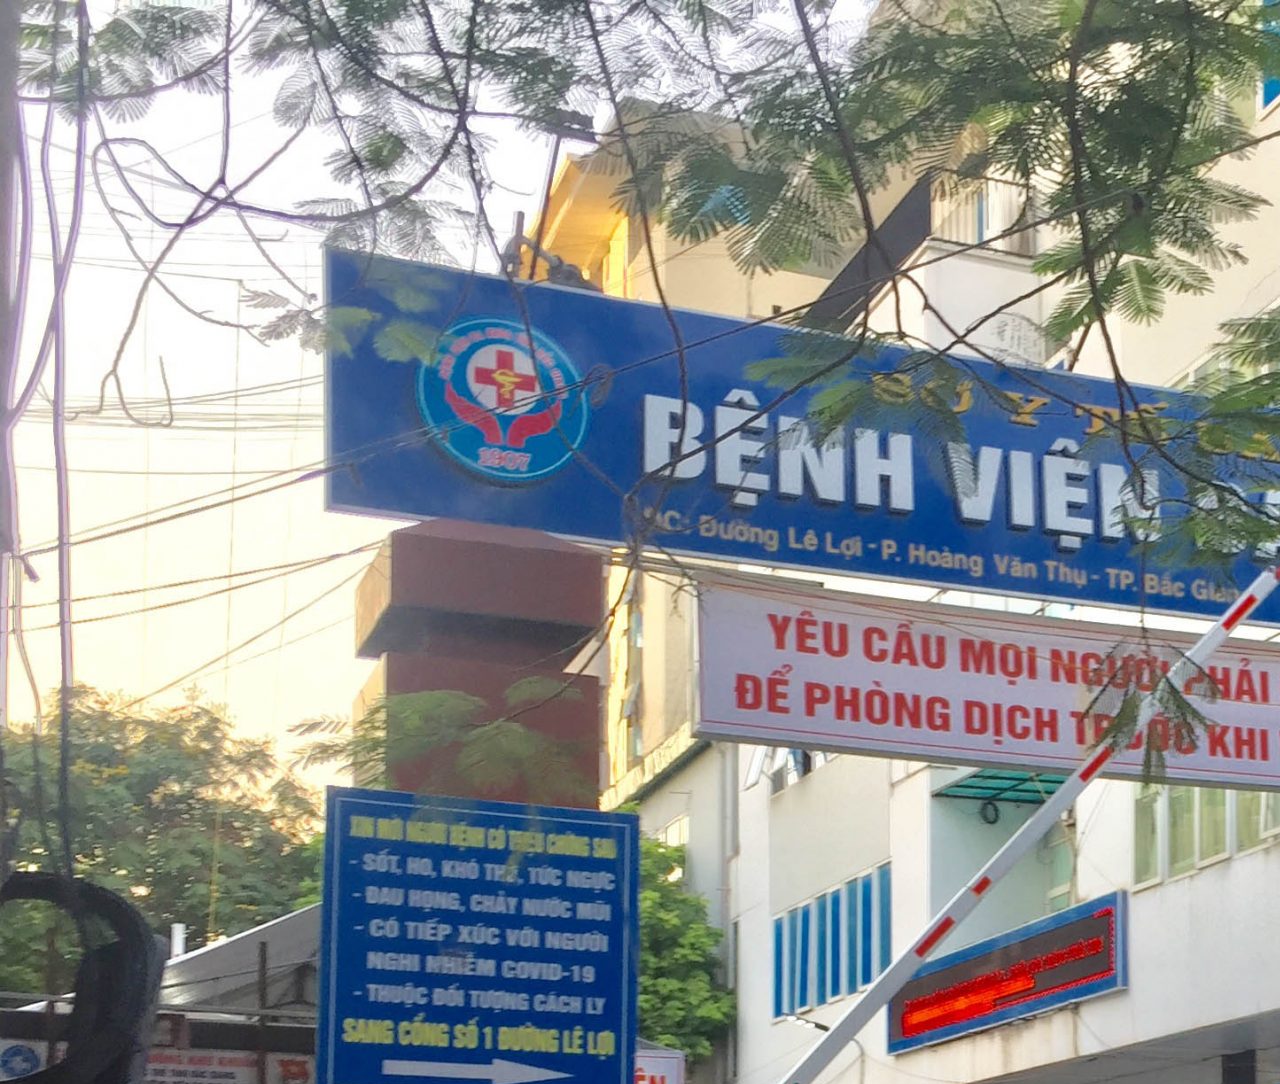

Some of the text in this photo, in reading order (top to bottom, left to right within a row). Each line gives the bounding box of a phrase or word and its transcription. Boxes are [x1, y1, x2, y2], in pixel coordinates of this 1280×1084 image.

[1003, 390, 1050, 428] Y
[643, 389, 915, 512] BỆNH
[948, 438, 1163, 549] VIỆN
[699, 514, 778, 551] Đường
[788, 525, 818, 549] Lê
[825, 532, 862, 557] Lợi
[880, 539, 902, 562] P.
[908, 543, 984, 577] Hoàng
[993, 554, 1038, 579] Văn
[1044, 560, 1088, 589] Thụ
[1105, 568, 1138, 592] TP.
[1143, 572, 1186, 597] Bắc
[1191, 579, 1242, 604] Gian
[768, 611, 849, 658] YÊU
[863, 620, 946, 670] CẦU
[959, 638, 1038, 686] MỌI
[1051, 648, 1169, 692] NGƯỜI
[734, 664, 792, 715] ĐỂ
[804, 680, 952, 733] PHÒNG
[964, 699, 1059, 745] DỊCH
[1070, 710, 1197, 757] TRỚC
[1207, 724, 1270, 762] KHI
[363, 848, 402, 875] SỐT,
[441, 858, 479, 880] KHÓ
[369, 916, 400, 938] CÓ
[404, 918, 453, 941] TIẾP
[457, 922, 501, 945] XÚC
[506, 926, 540, 948] VỚI
[544, 930, 609, 952] NGƯỜI
[501, 960, 596, 983] COVID-19
[533, 991, 583, 1014] CÁCH
[586, 997, 607, 1015] LY
[342, 1018, 395, 1044] SANG
[453, 1016, 479, 1050] SỐ
[483, 1026, 493, 1050] 1
[562, 1025, 585, 1054] LÊ
[587, 1030, 616, 1060] LỢI
